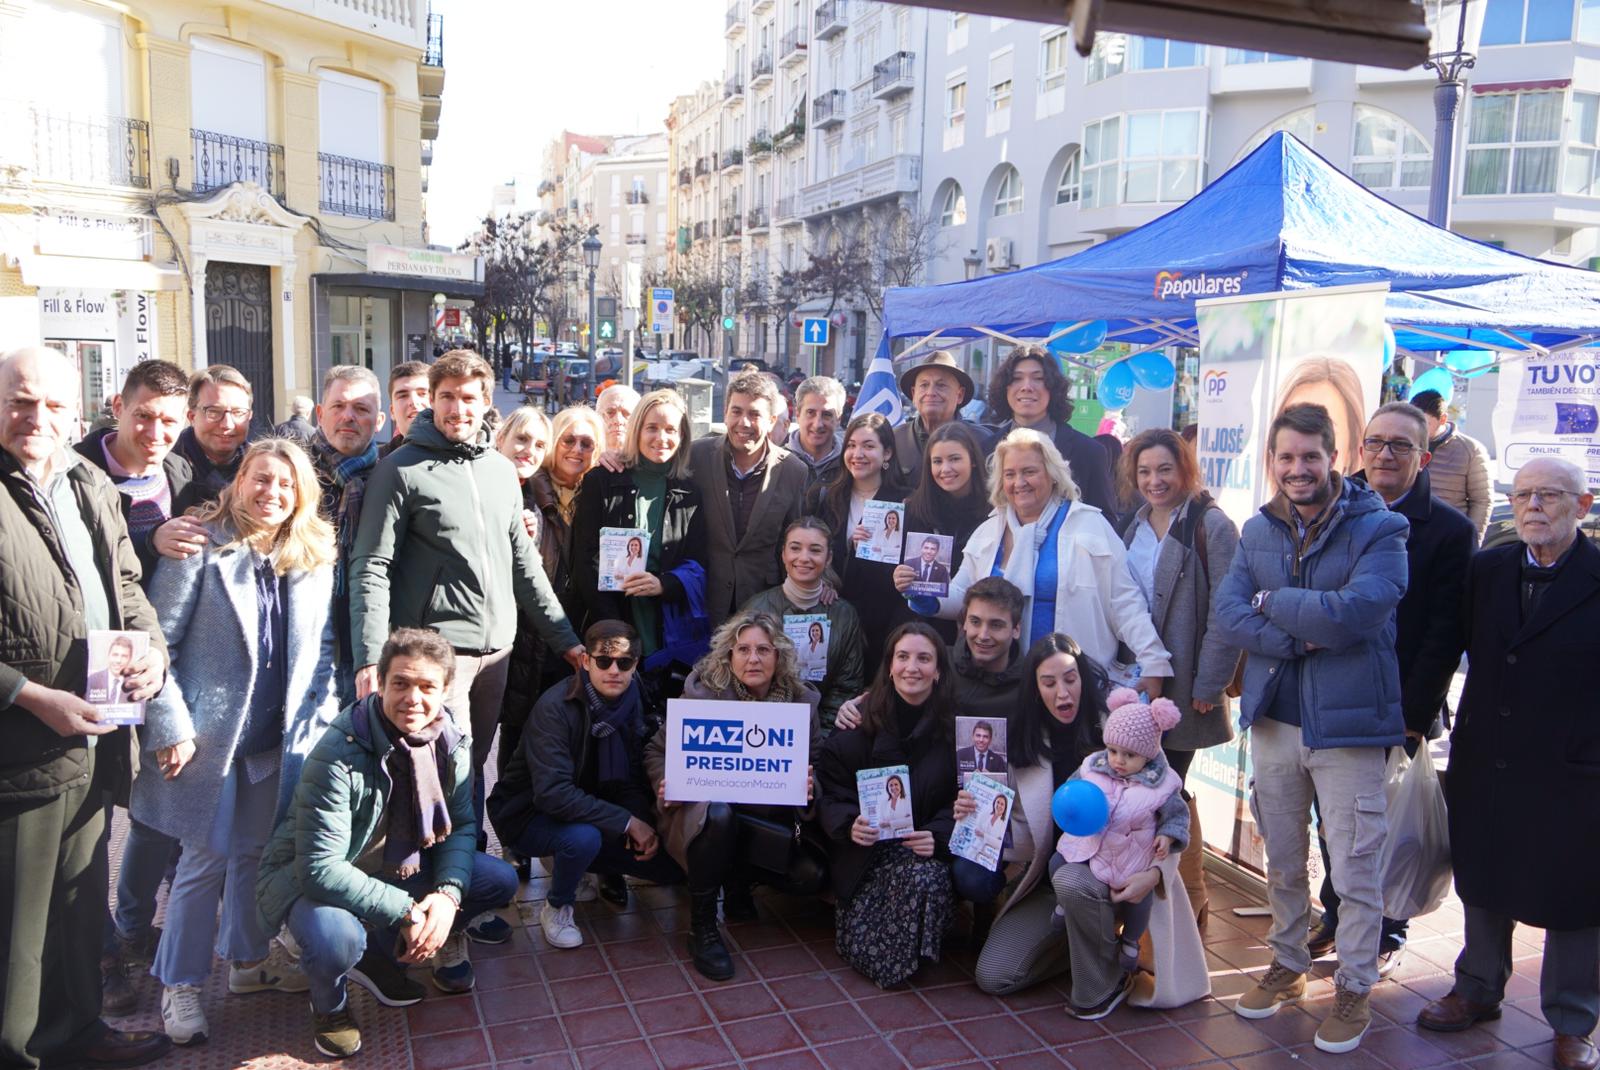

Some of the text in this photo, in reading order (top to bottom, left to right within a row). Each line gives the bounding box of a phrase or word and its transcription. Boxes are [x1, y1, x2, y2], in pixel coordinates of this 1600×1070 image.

[387, 262, 430, 273] PERSIANAS
[1161, 272, 1241, 299] populares
[43, 298, 105, 313] Fill & Flow
[136, 294, 147, 344] Flow
[1528, 365, 1559, 384] TU
[1528, 387, 1560, 395] TAMBIÉN
[686, 755, 792, 773] PRESIDENT
[686, 777, 787, 790] #ValenciaconMazón
